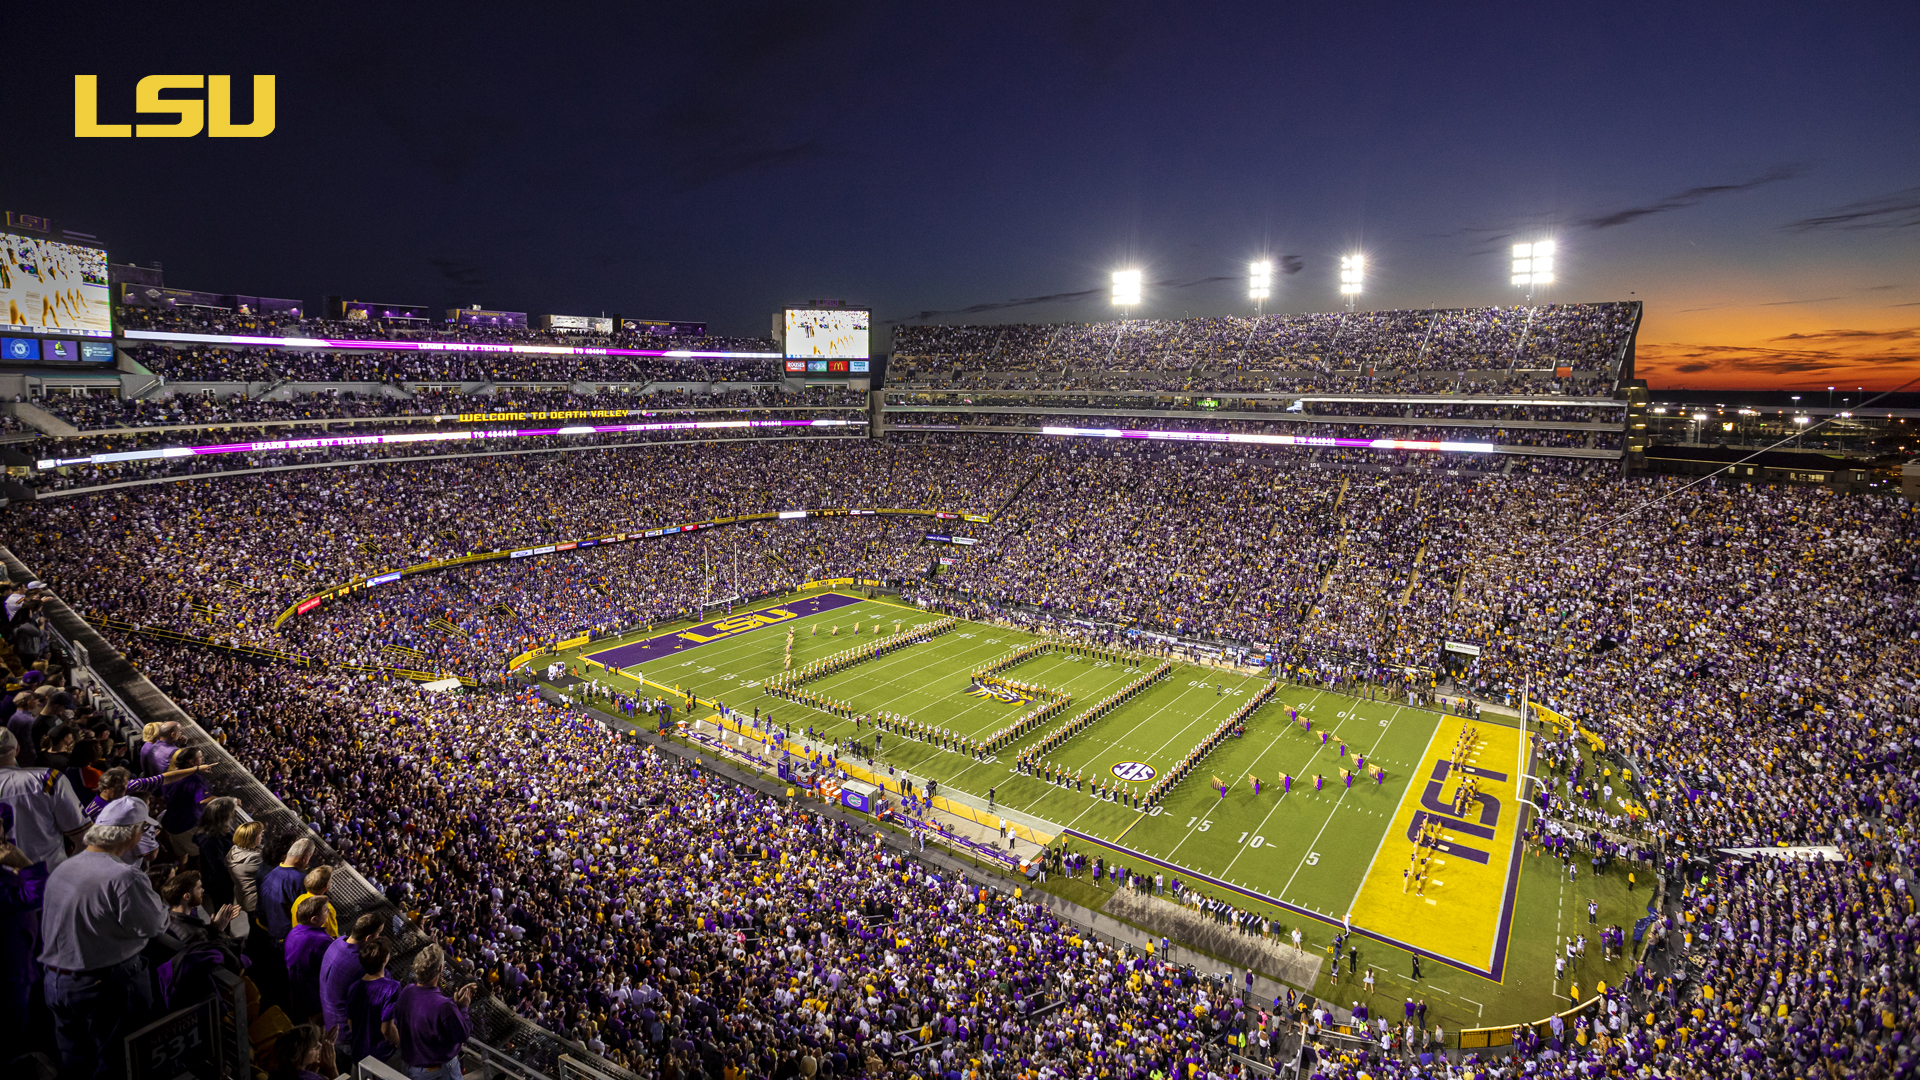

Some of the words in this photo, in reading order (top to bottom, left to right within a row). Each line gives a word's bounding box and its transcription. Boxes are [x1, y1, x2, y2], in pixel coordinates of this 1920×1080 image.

[5, 211, 50, 232] LSU
[459, 412, 526, 423] WELCOME
[531, 411, 546, 420] TO
[550, 410, 586, 420] DEATH
[590, 409, 629, 418] VALLEY
[473, 431, 485, 439] TO
[251, 442, 285, 451] LEARN
[676, 608, 798, 644] LSU
[531, 648, 546, 658] LSU
[1113, 761, 1156, 781] SEC
[1406, 759, 1508, 865] LSU
[1186, 816, 1213, 832] 15
[1237, 831, 1265, 849] 10
[1306, 851, 1321, 866] 5
[152, 1026, 202, 1070] 531
